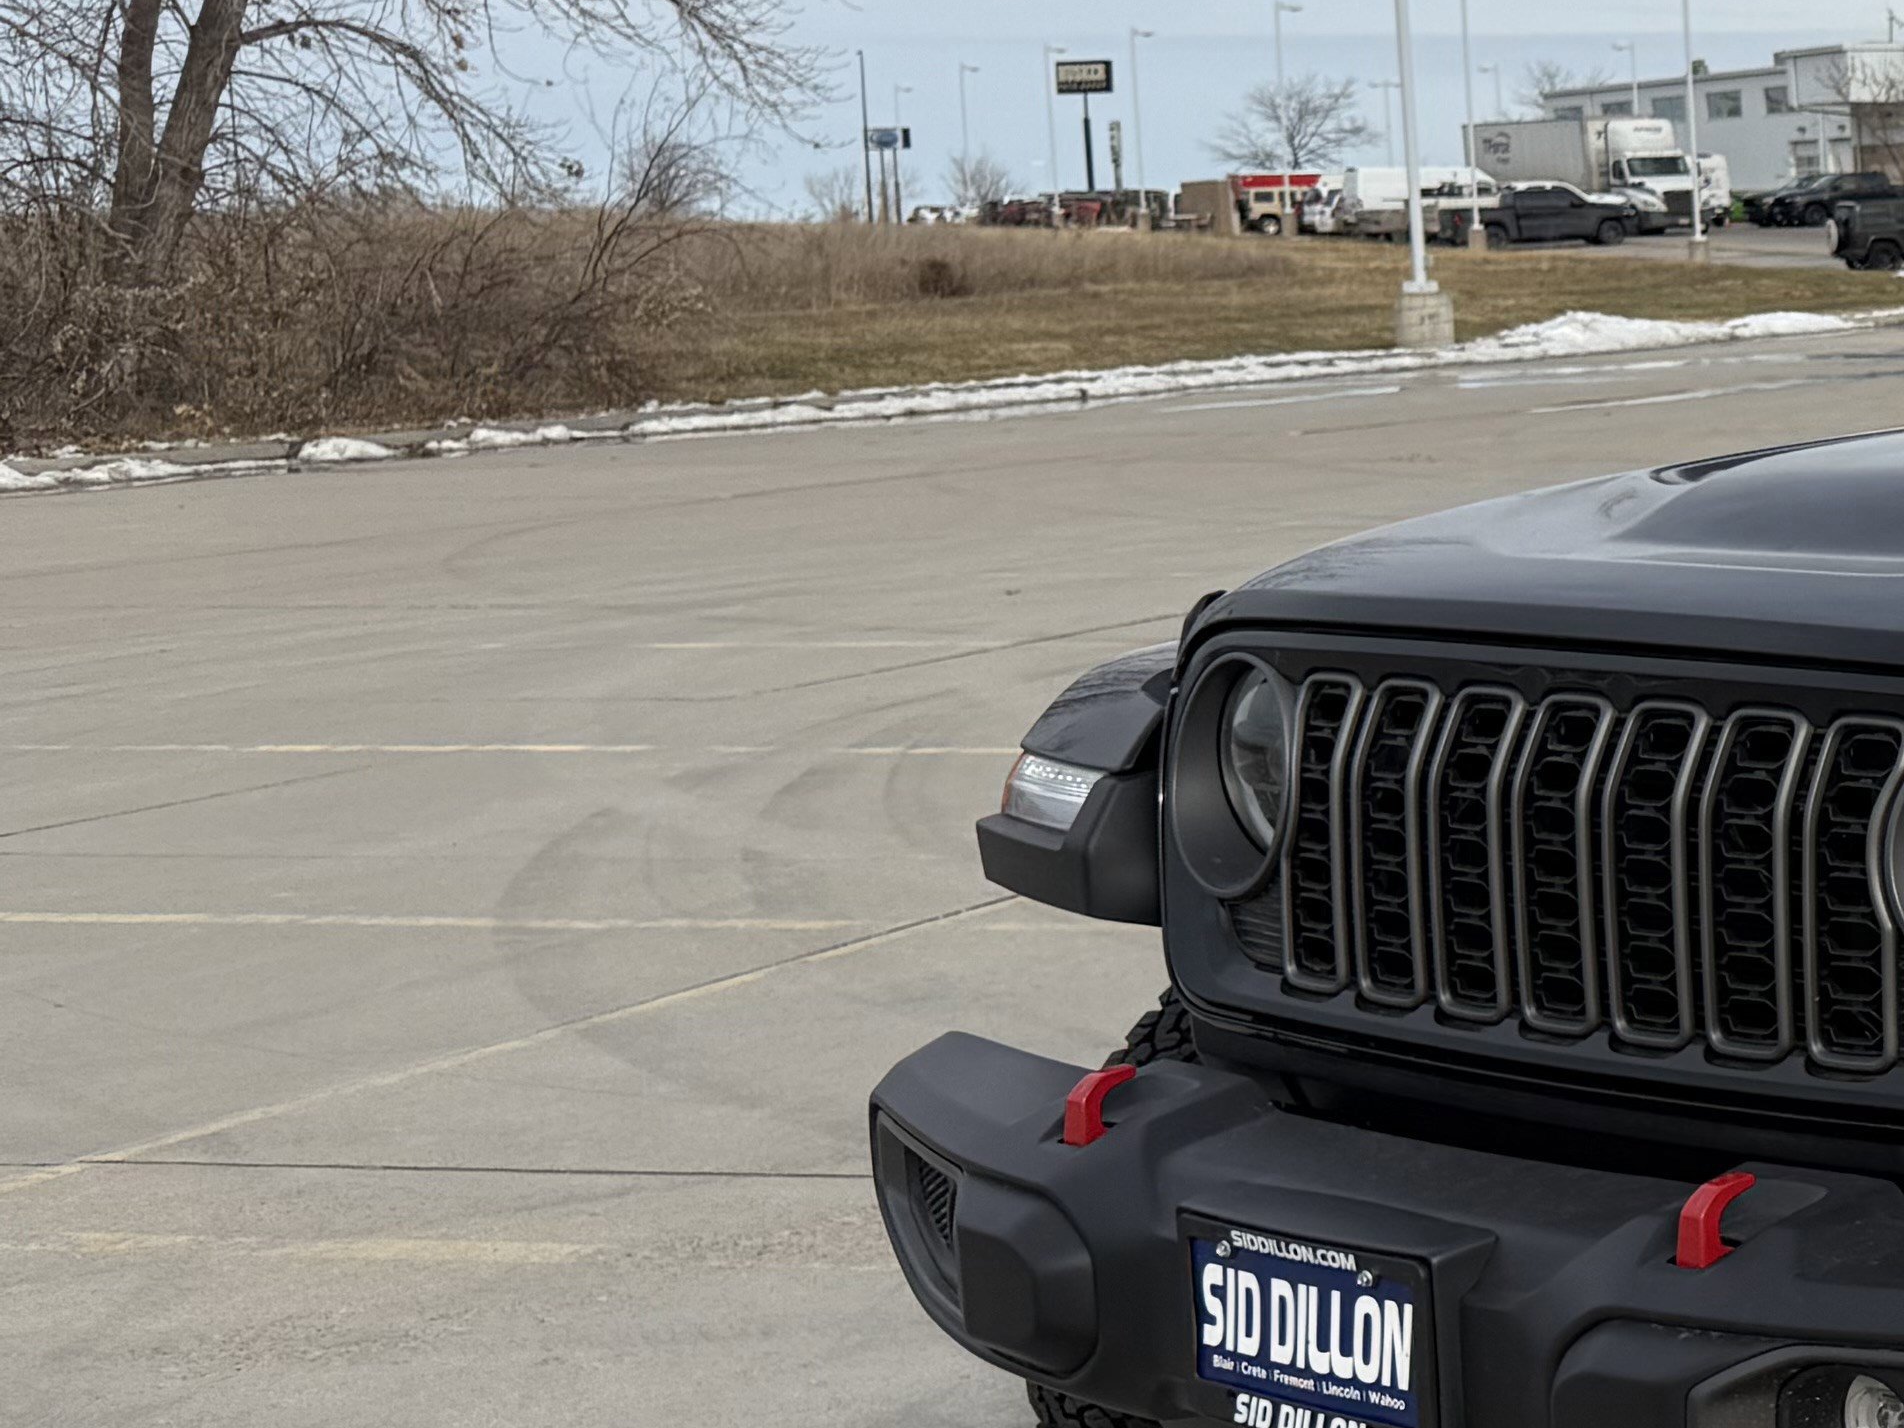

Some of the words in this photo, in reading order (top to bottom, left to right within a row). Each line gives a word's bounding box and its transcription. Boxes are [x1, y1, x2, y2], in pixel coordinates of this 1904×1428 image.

[1230, 1230, 1357, 1271] SIDDILLON.COM
[1203, 1262, 1262, 1358] SID
[1269, 1276, 1413, 1392] DILLON
[1212, 1354, 1235, 1371] Blair
[1240, 1364, 1267, 1379] Crete
[1273, 1369, 1316, 1391] Fremont
[1322, 1380, 1361, 1401] Lincoln
[1368, 1389, 1406, 1411] Wahoo
